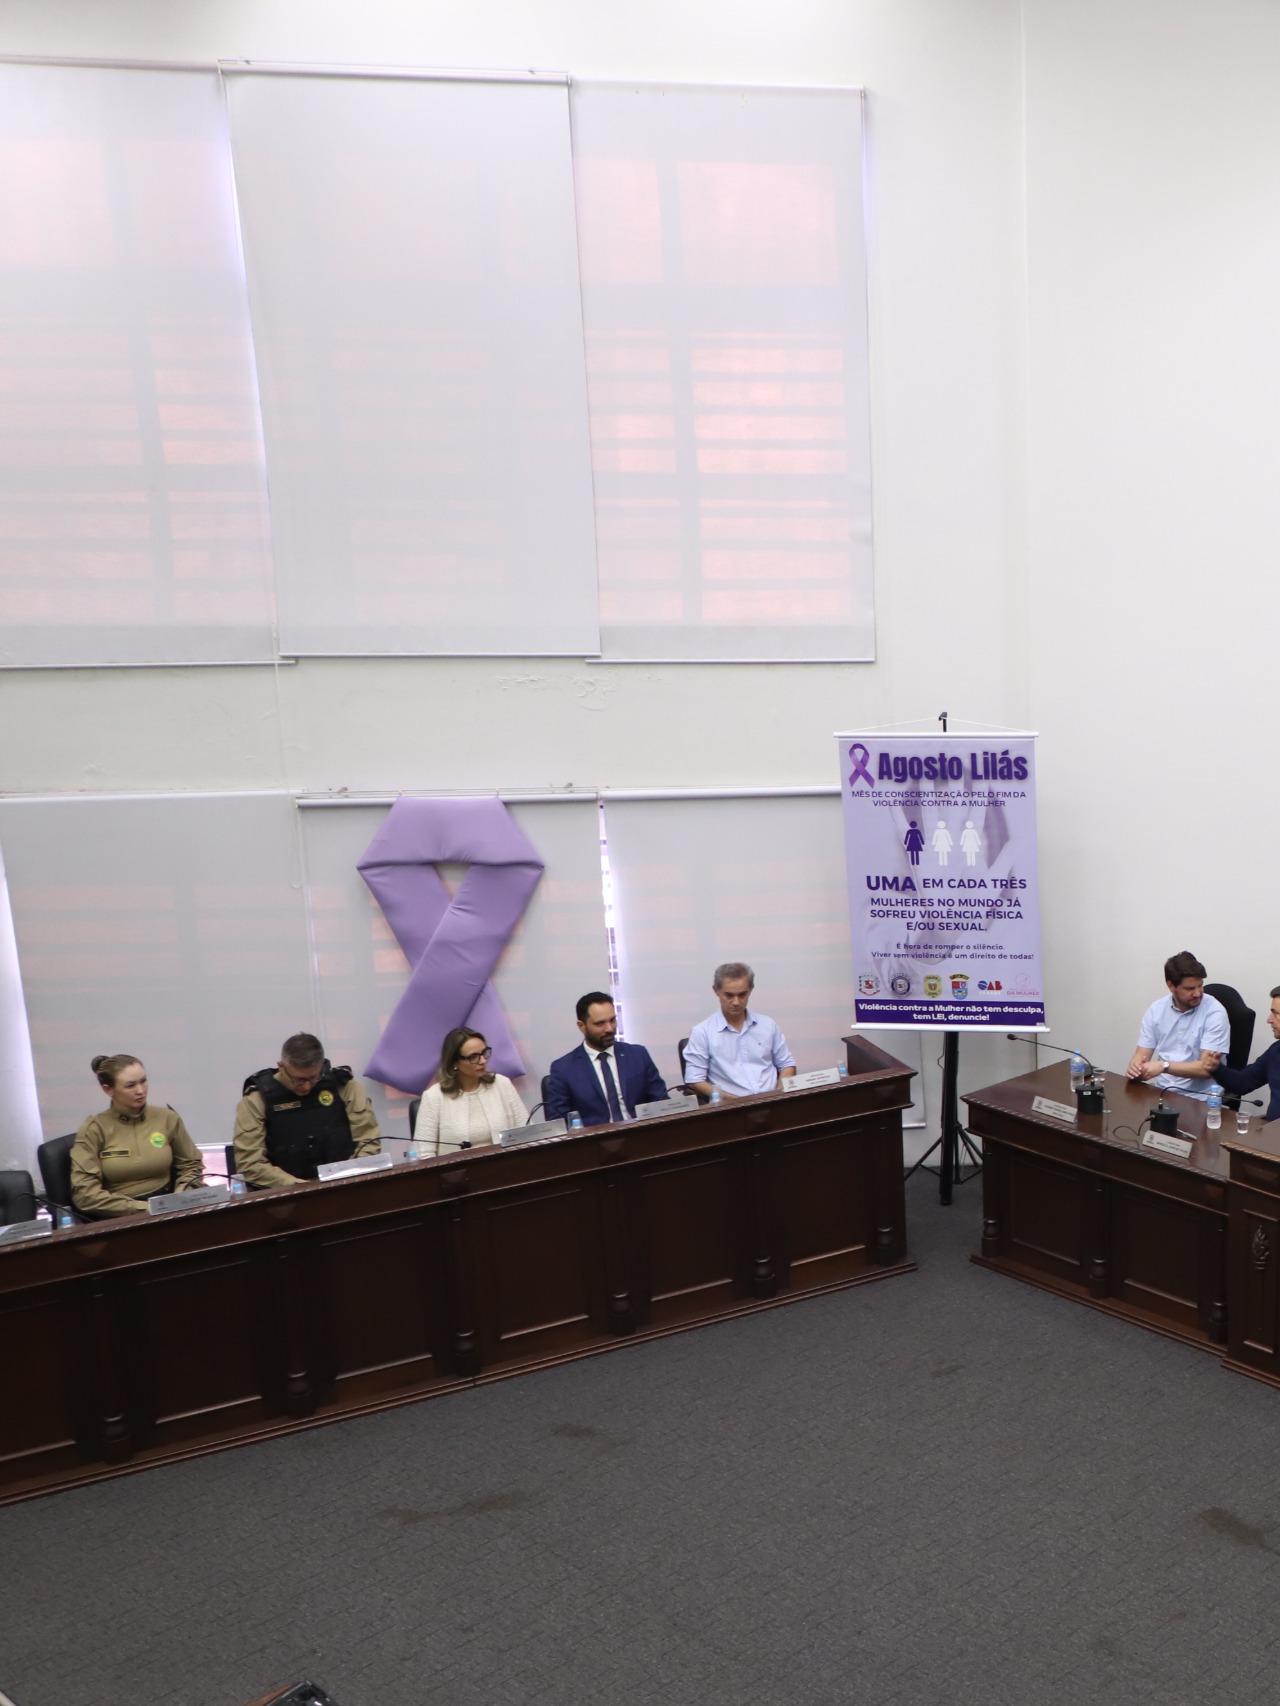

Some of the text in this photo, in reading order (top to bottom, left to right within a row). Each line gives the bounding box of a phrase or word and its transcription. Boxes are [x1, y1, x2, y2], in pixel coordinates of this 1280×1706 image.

[878, 749, 1028, 783] Agosto Lilás
[851, 790, 870, 798] MÊS
[884, 790, 970, 799] CONSCIENTIZAÇÃO
[873, 799, 920, 807] VIOLÊNCIA
[866, 875, 1027, 892] UMA EM CADA TRÊS
[870, 897, 1022, 908] MULHERES NO MUNDO JÁ
[870, 908, 1024, 919] SOFREU VIOLÊNCIA FÍSICA
[906, 921, 988, 931] E/OU SEXUAL.
[977, 980, 1003, 991] OAB
[858, 1003, 898, 1011] Violência
[898, 1004, 928, 1012] contra
[934, 1004, 965, 1012] Mulher
[965, 1005, 983, 1013] não
[983, 1005, 1002, 1013] tem
[1002, 1005, 1044, 1015] desculpa,
[948, 1013, 990, 1021] denuncie!
